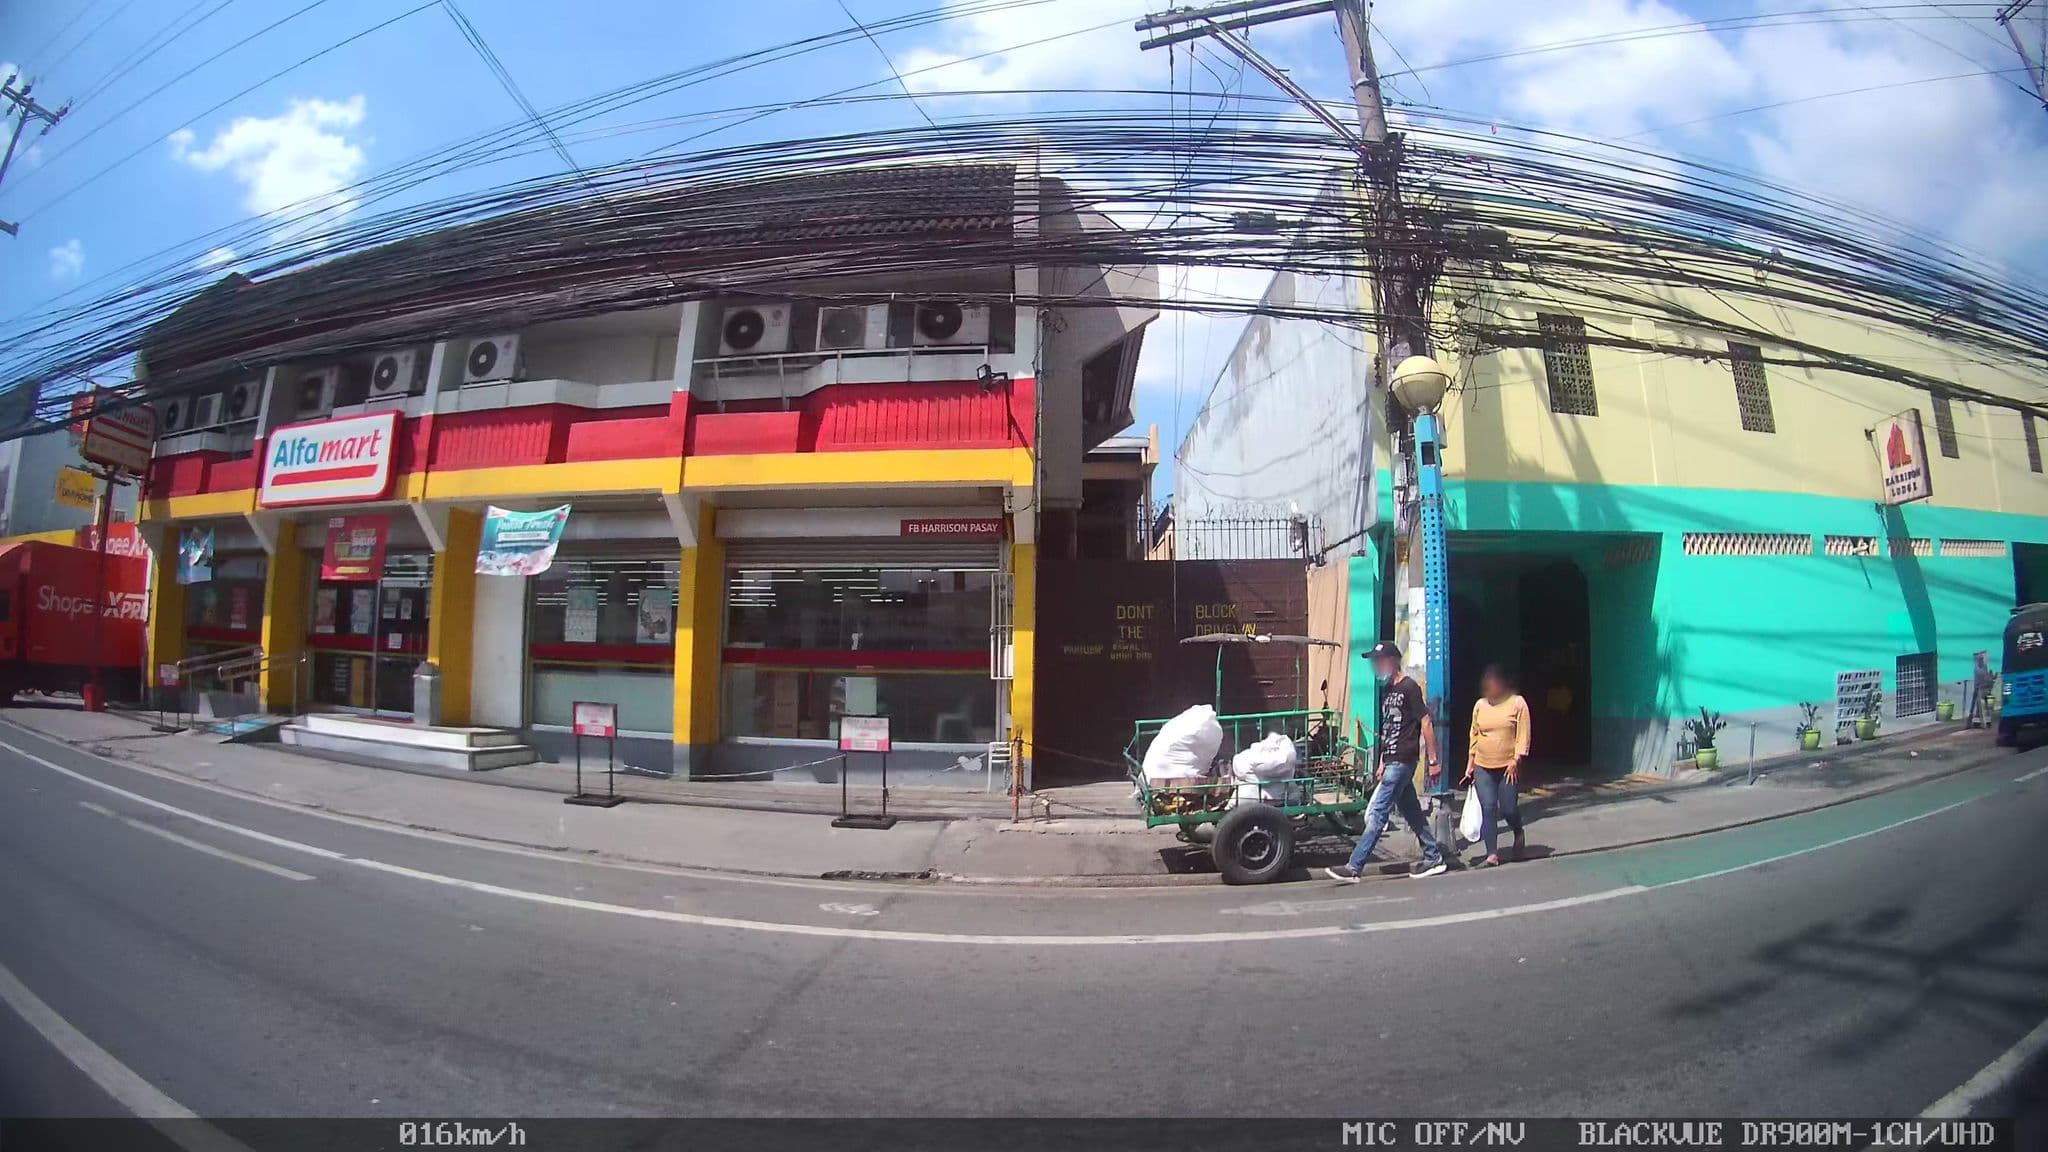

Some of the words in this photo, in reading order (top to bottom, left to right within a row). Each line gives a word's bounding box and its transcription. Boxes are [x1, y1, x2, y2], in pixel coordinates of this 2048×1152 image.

[273, 429, 382, 467] Alfamart
[1891, 481, 1918, 497] LODGE
[908, 523, 920, 533] FB
[921, 523, 968, 533] HARRISON
[970, 523, 998, 533] PASAY
[37, 585, 101, 620] Shope
[1116, 605, 1155, 620] DONT
[1195, 604, 1236, 619] BLOCK
[1120, 625, 1143, 639] THE
